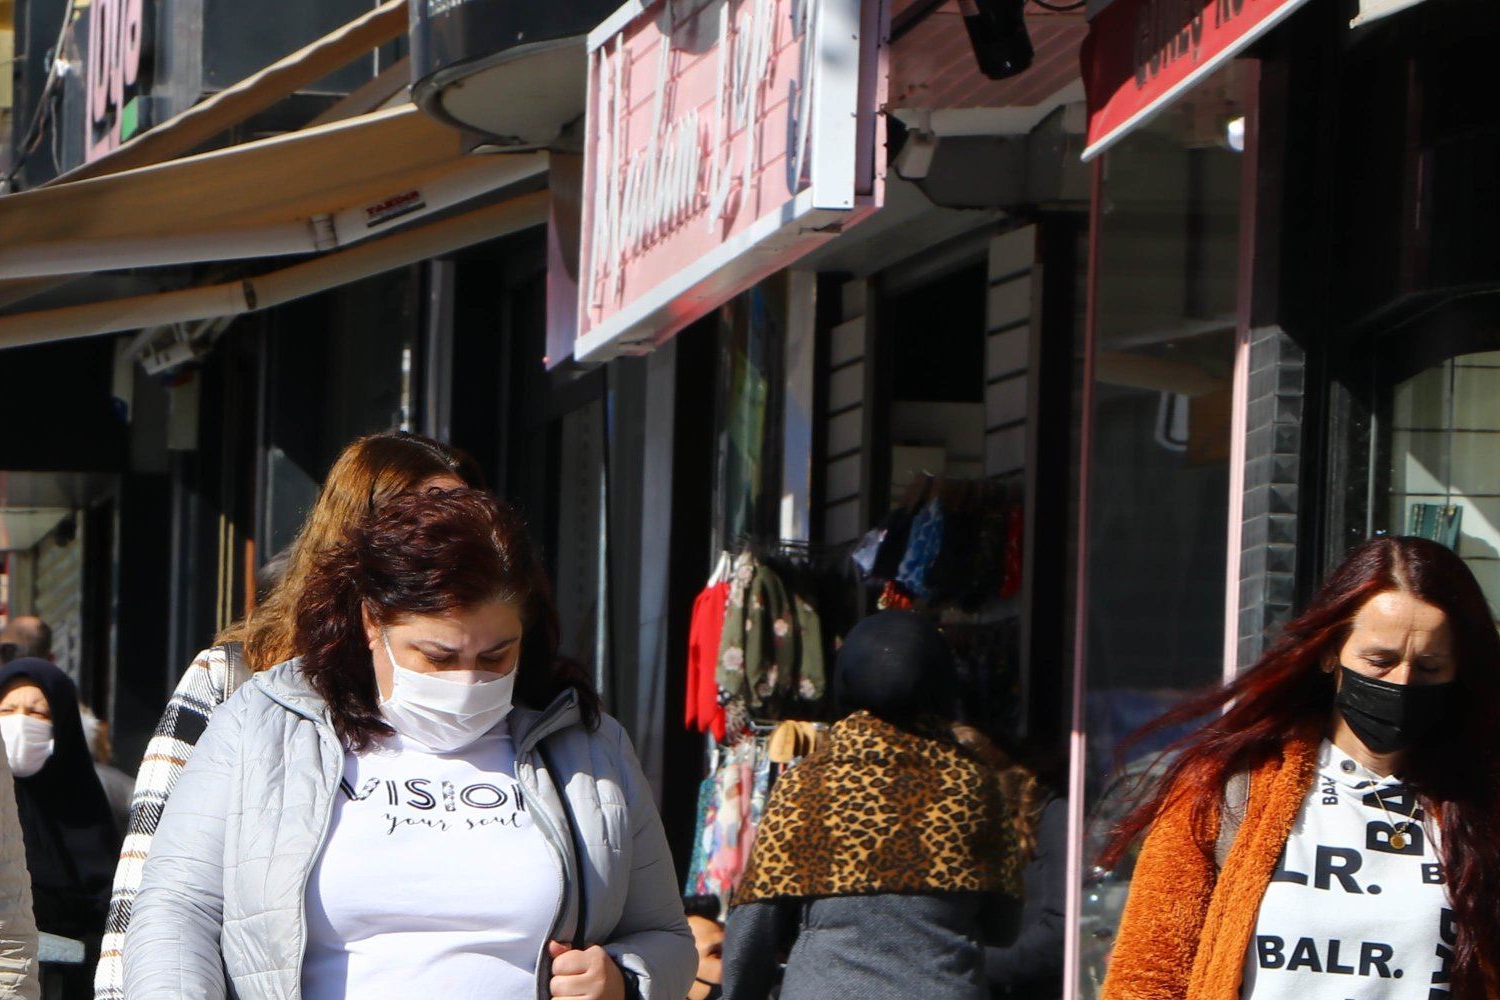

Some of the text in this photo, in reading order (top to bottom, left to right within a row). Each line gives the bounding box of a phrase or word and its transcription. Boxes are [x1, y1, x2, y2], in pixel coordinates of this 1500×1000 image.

[382, 811, 525, 836] your soul
[1257, 935, 1404, 979] BALR.
